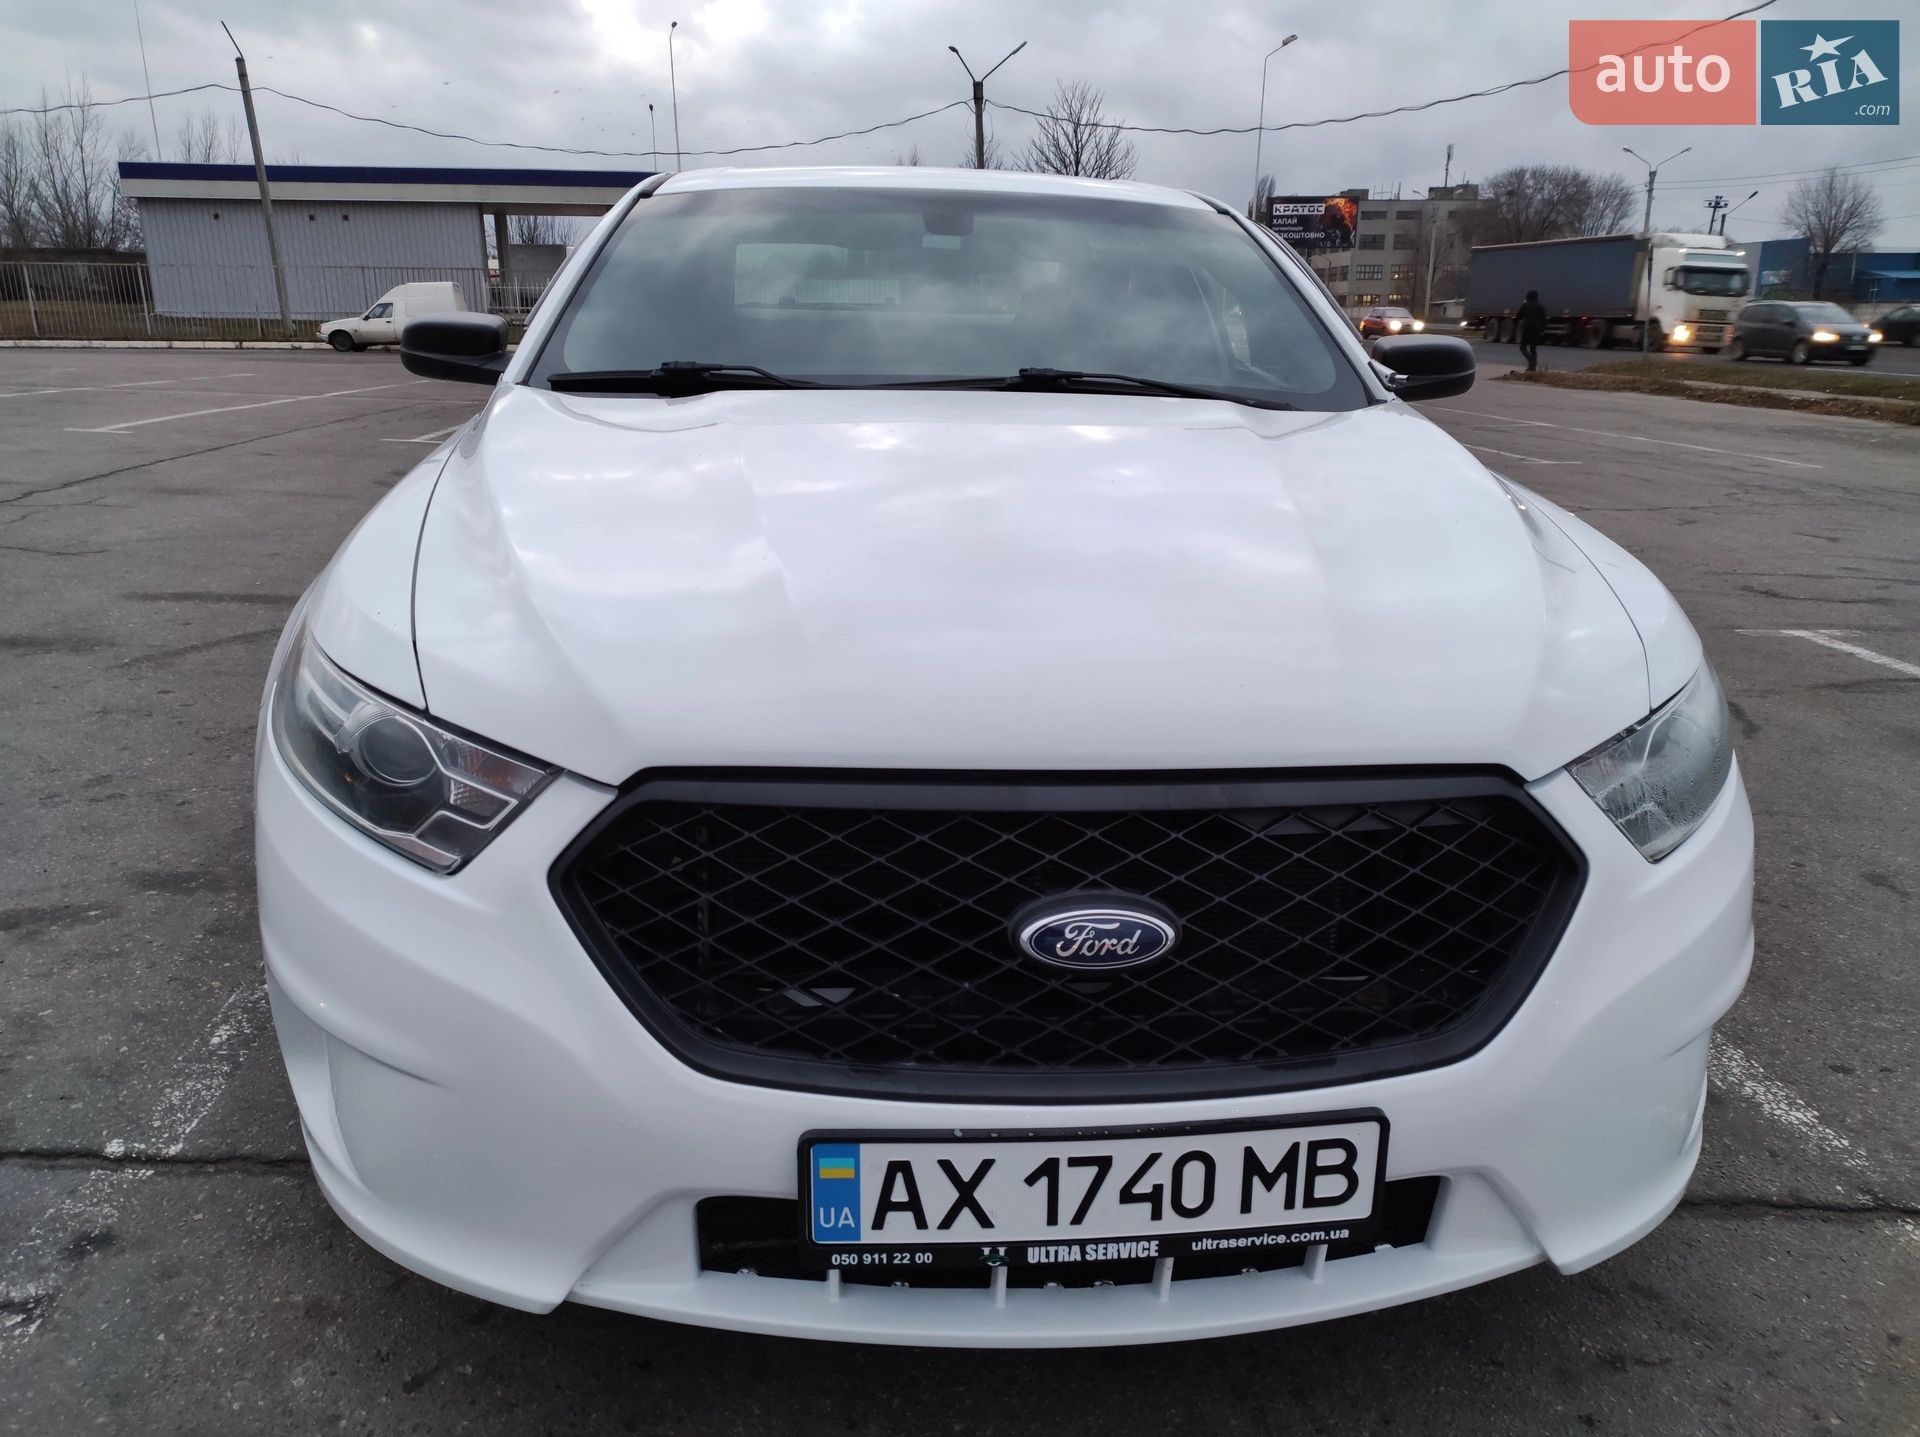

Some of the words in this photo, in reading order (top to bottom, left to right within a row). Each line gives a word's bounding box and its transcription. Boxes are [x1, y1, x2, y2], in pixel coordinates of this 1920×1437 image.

[1274, 205, 1323, 213] КРАТОС
[1272, 217, 1298, 225] ХАПАЙ
[1055, 922, 1142, 957] Ford
[871, 1158, 996, 1230] AX
[1023, 1149, 1216, 1226] 1740
[1240, 1138, 1359, 1214] MB
[819, 1206, 855, 1228] UA
[1191, 1228, 1350, 1251] ultraservice.com.ua
[831, 1253, 858, 1266] 050
[862, 1253, 887, 1265] 911
[893, 1252, 911, 1264] 22
[915, 1252, 933, 1264] 00
[1027, 1244, 1082, 1264] ULTRA
[1085, 1240, 1159, 1261] SERVICE
